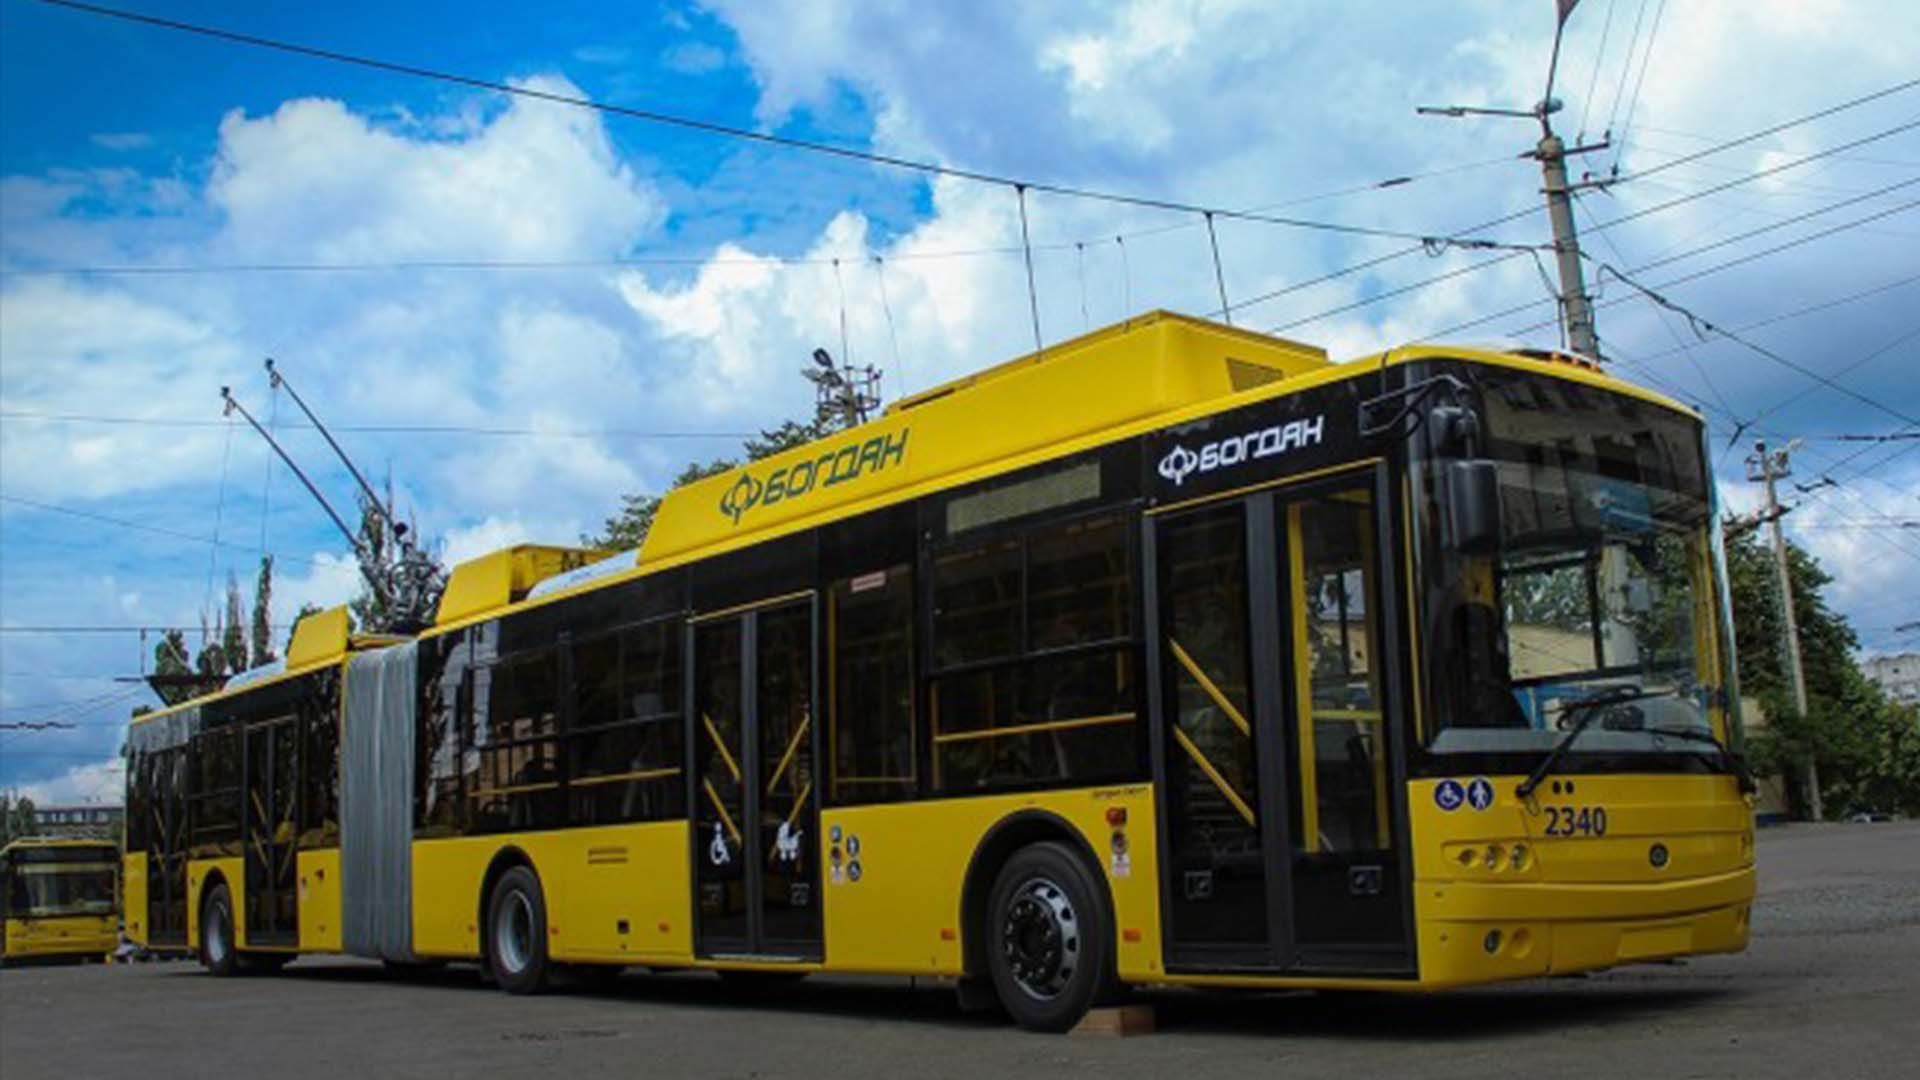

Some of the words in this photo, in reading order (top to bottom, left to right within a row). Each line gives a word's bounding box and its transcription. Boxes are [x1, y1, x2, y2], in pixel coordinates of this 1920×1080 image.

[762, 428, 909, 506] БОГДАН
[1199, 414, 1324, 473] БОГДАН
[1544, 806, 1607, 836] 2340
